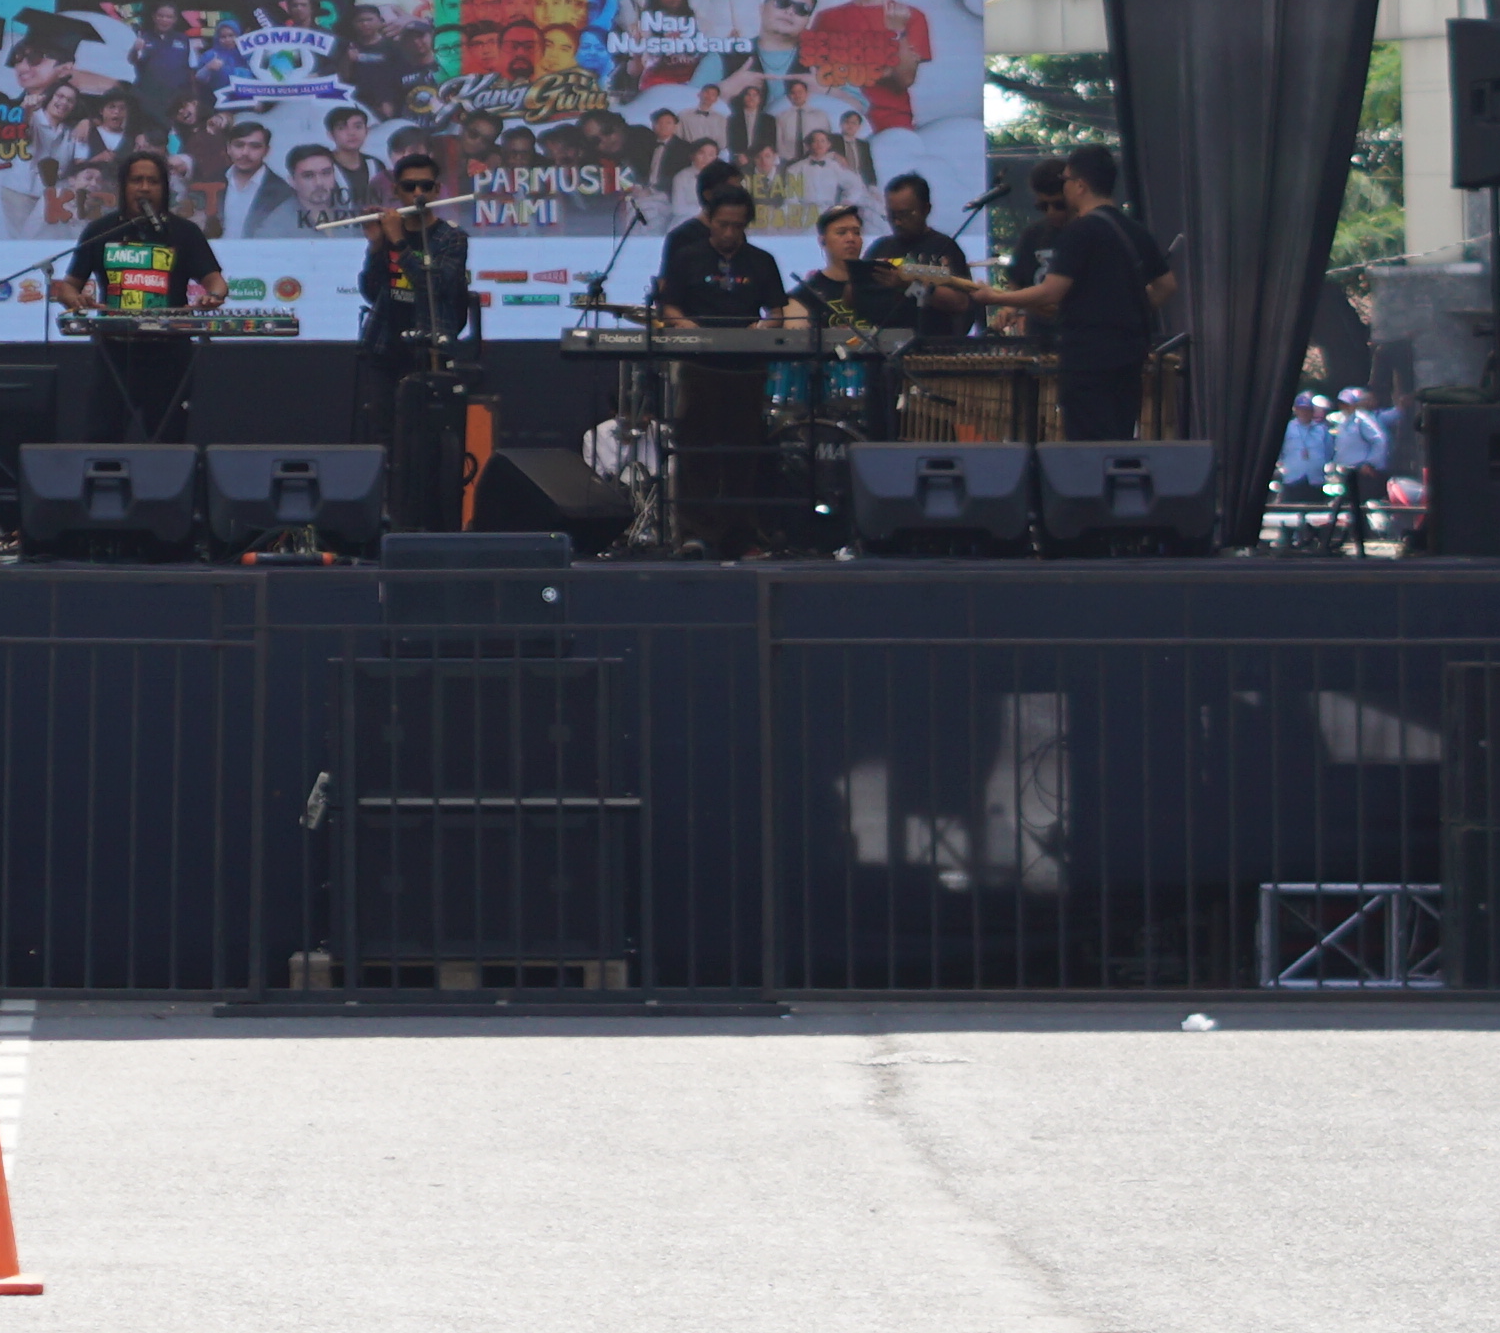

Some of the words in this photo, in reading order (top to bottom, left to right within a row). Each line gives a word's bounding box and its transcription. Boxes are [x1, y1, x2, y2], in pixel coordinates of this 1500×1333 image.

[641, 11, 697, 37] Nay
[240, 31, 327, 51] KOMJAL
[606, 31, 752, 54] Nusantara
[435, 72, 528, 124] Kang
[523, 71, 607, 124] Guru
[474, 199, 559, 226] NAMI
[598, 333, 643, 344] Roland
